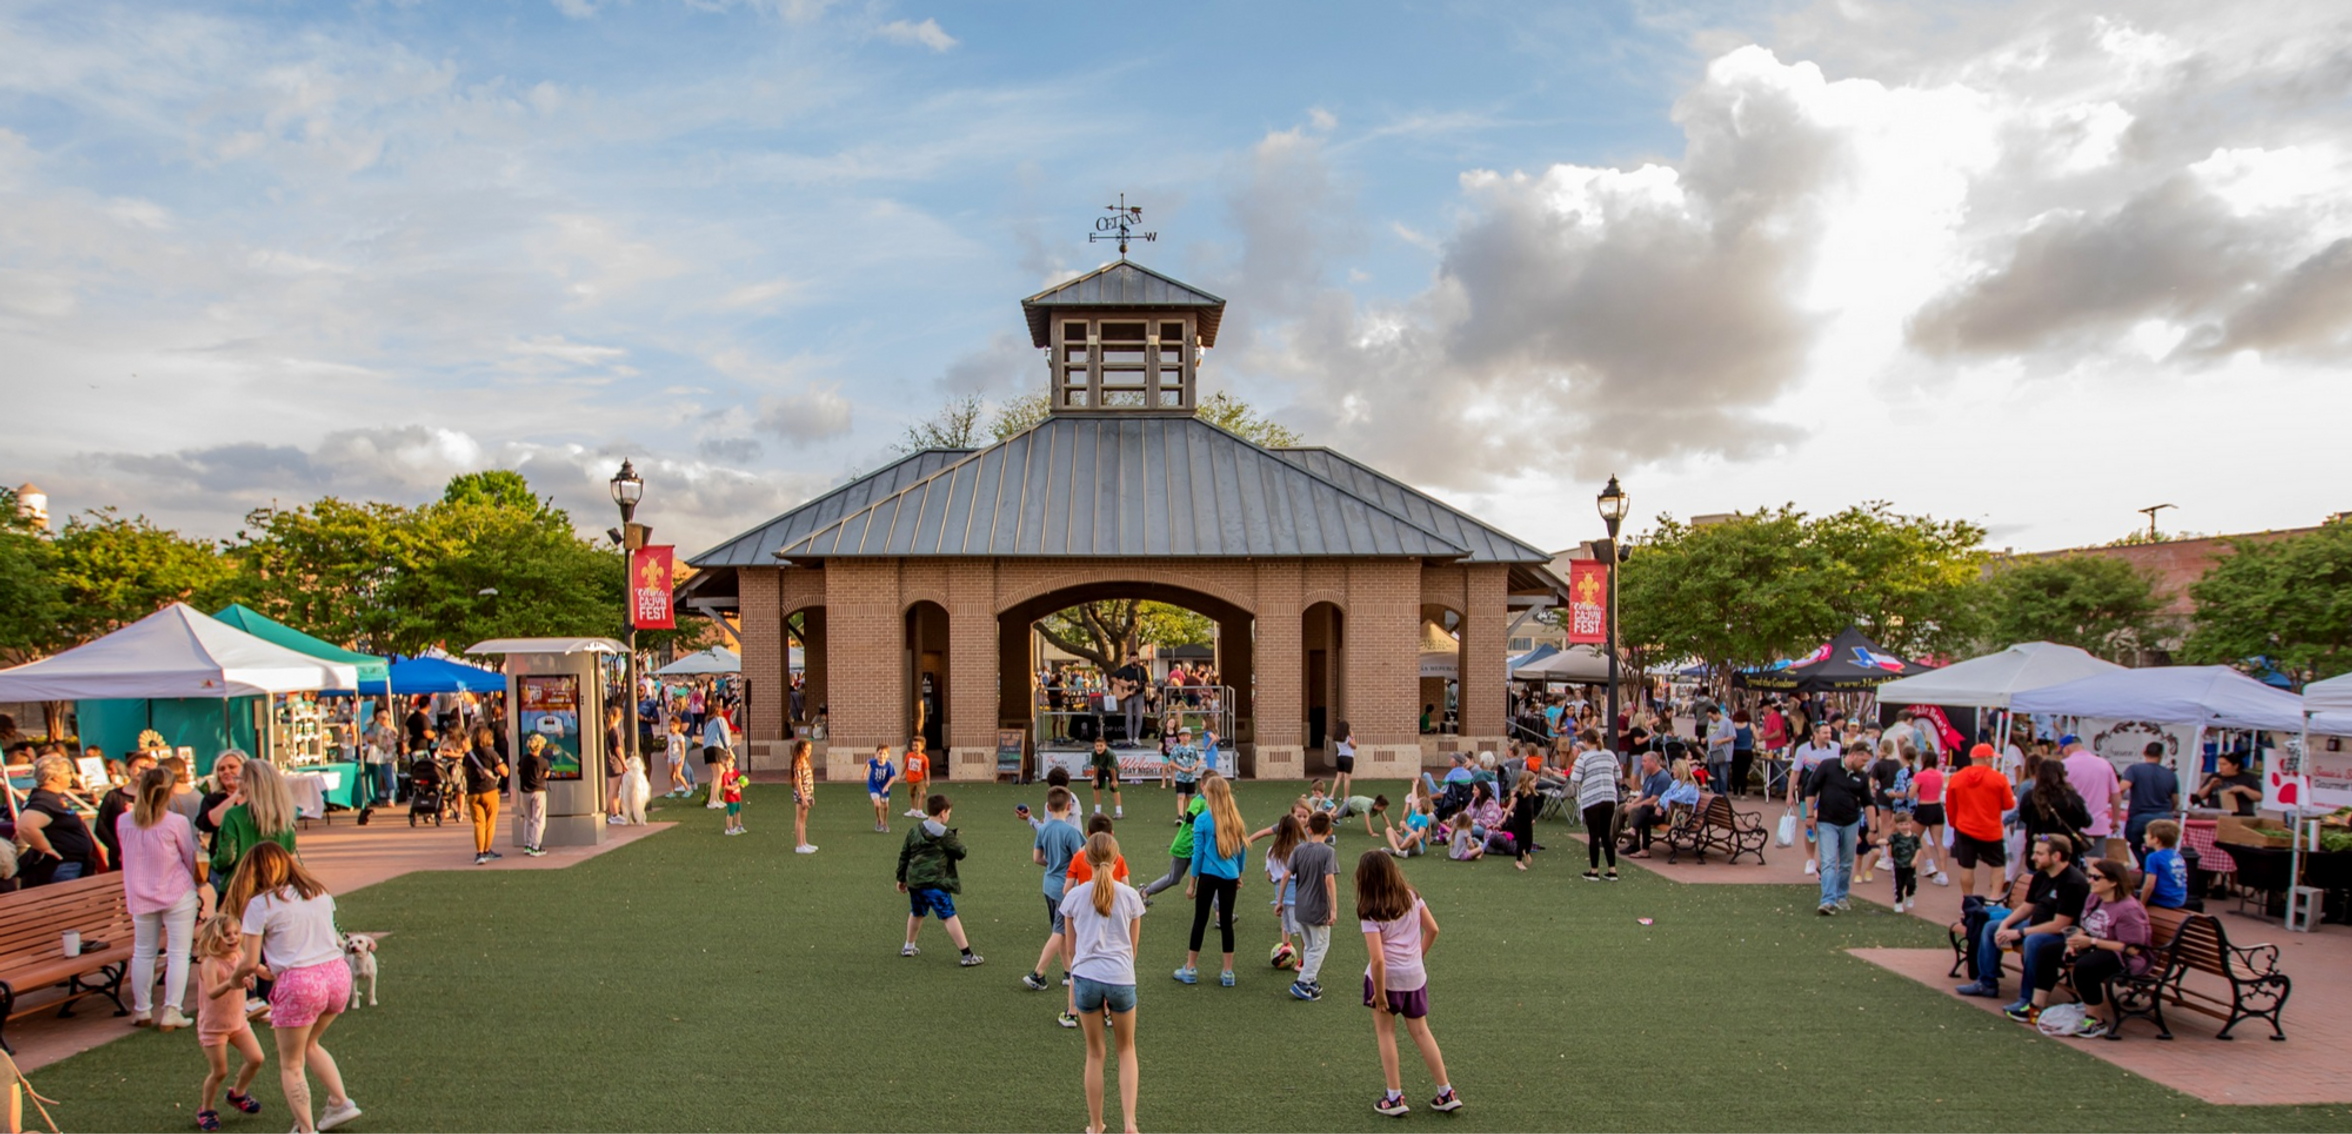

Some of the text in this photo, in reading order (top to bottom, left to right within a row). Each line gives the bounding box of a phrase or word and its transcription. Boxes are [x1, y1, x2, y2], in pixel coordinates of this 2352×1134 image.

[1089, 232, 1096, 243] E
[1145, 232, 1157, 242] W
[639, 606, 667, 621] FEST
[1574, 619, 1601, 634] FEST
[1118, 756, 1163, 769] Welcom
